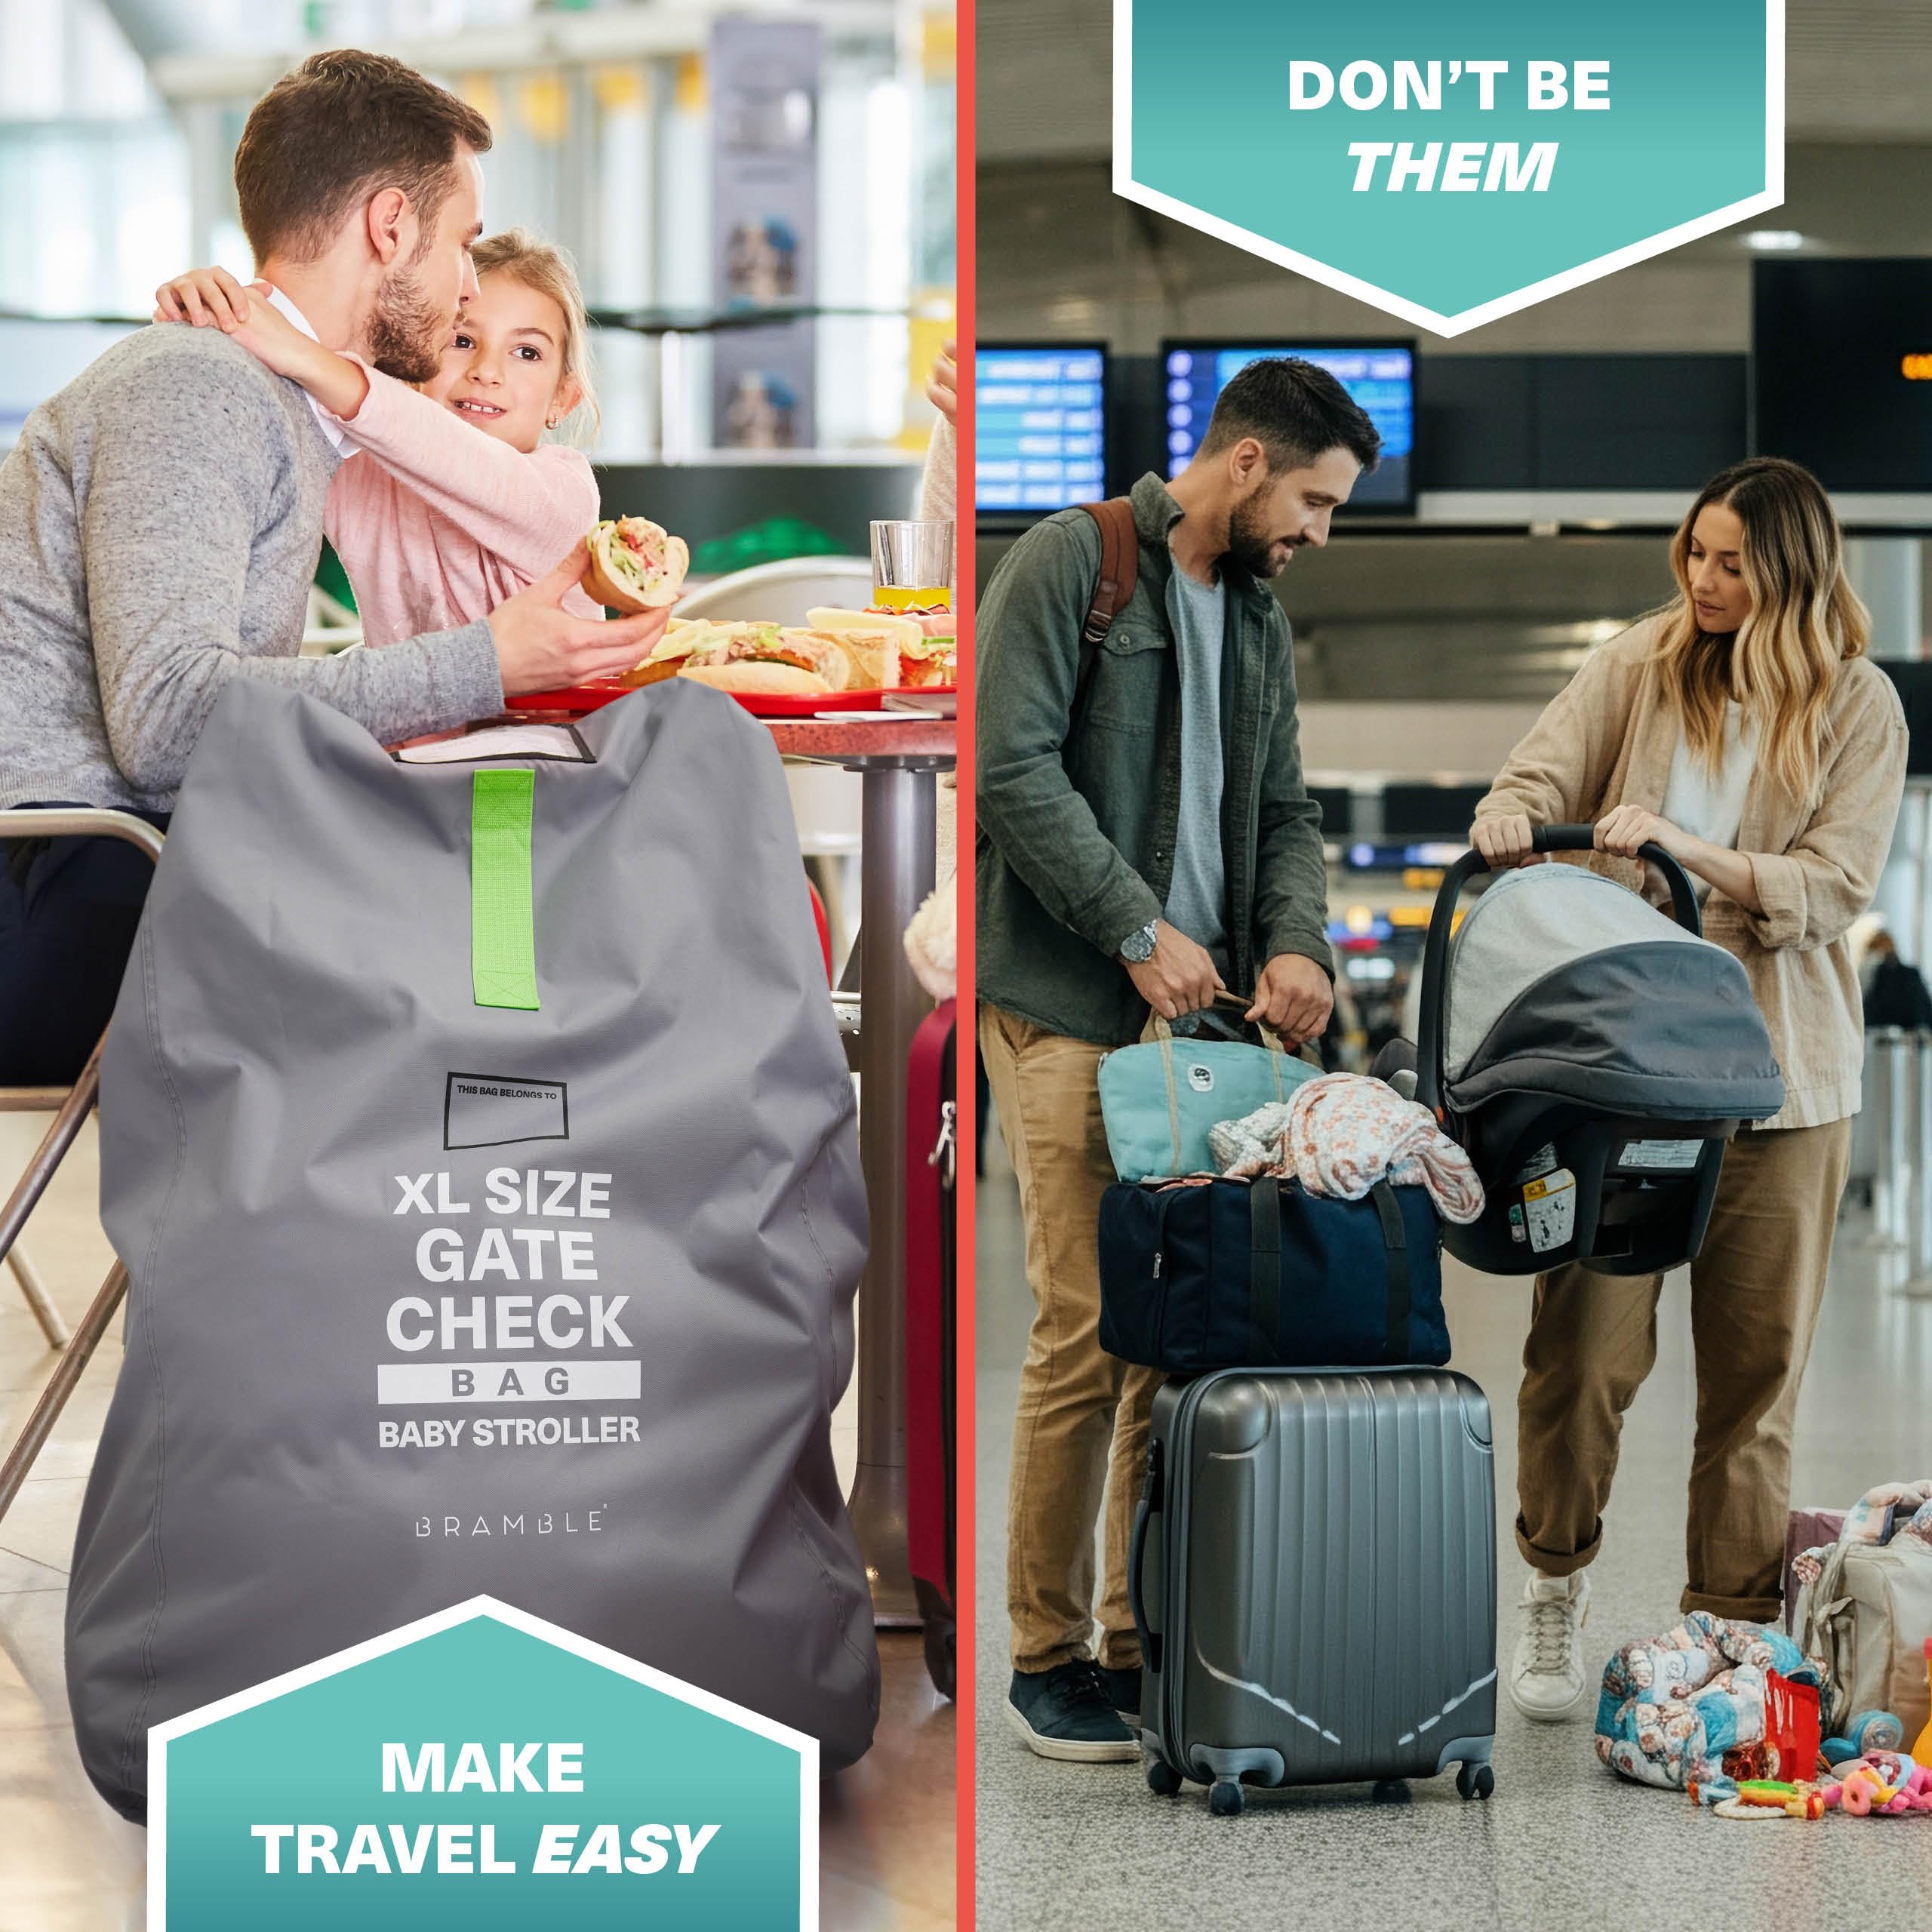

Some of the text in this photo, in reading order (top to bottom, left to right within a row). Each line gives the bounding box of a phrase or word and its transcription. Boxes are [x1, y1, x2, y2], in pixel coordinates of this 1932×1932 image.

[457, 1084, 478, 1095] THIS
[479, 1087, 498, 1097] BAG
[499, 1088, 543, 1100] BELONGS
[392, 1167, 613, 1219] XL SIZE
[416, 1228, 598, 1282] GATE
[386, 1294, 634, 1352] CHECK
[451, 1367, 570, 1398] BAG
[379, 1416, 641, 1447] BABY STROLLER
[416, 1511, 601, 1537] BRAMBLE
